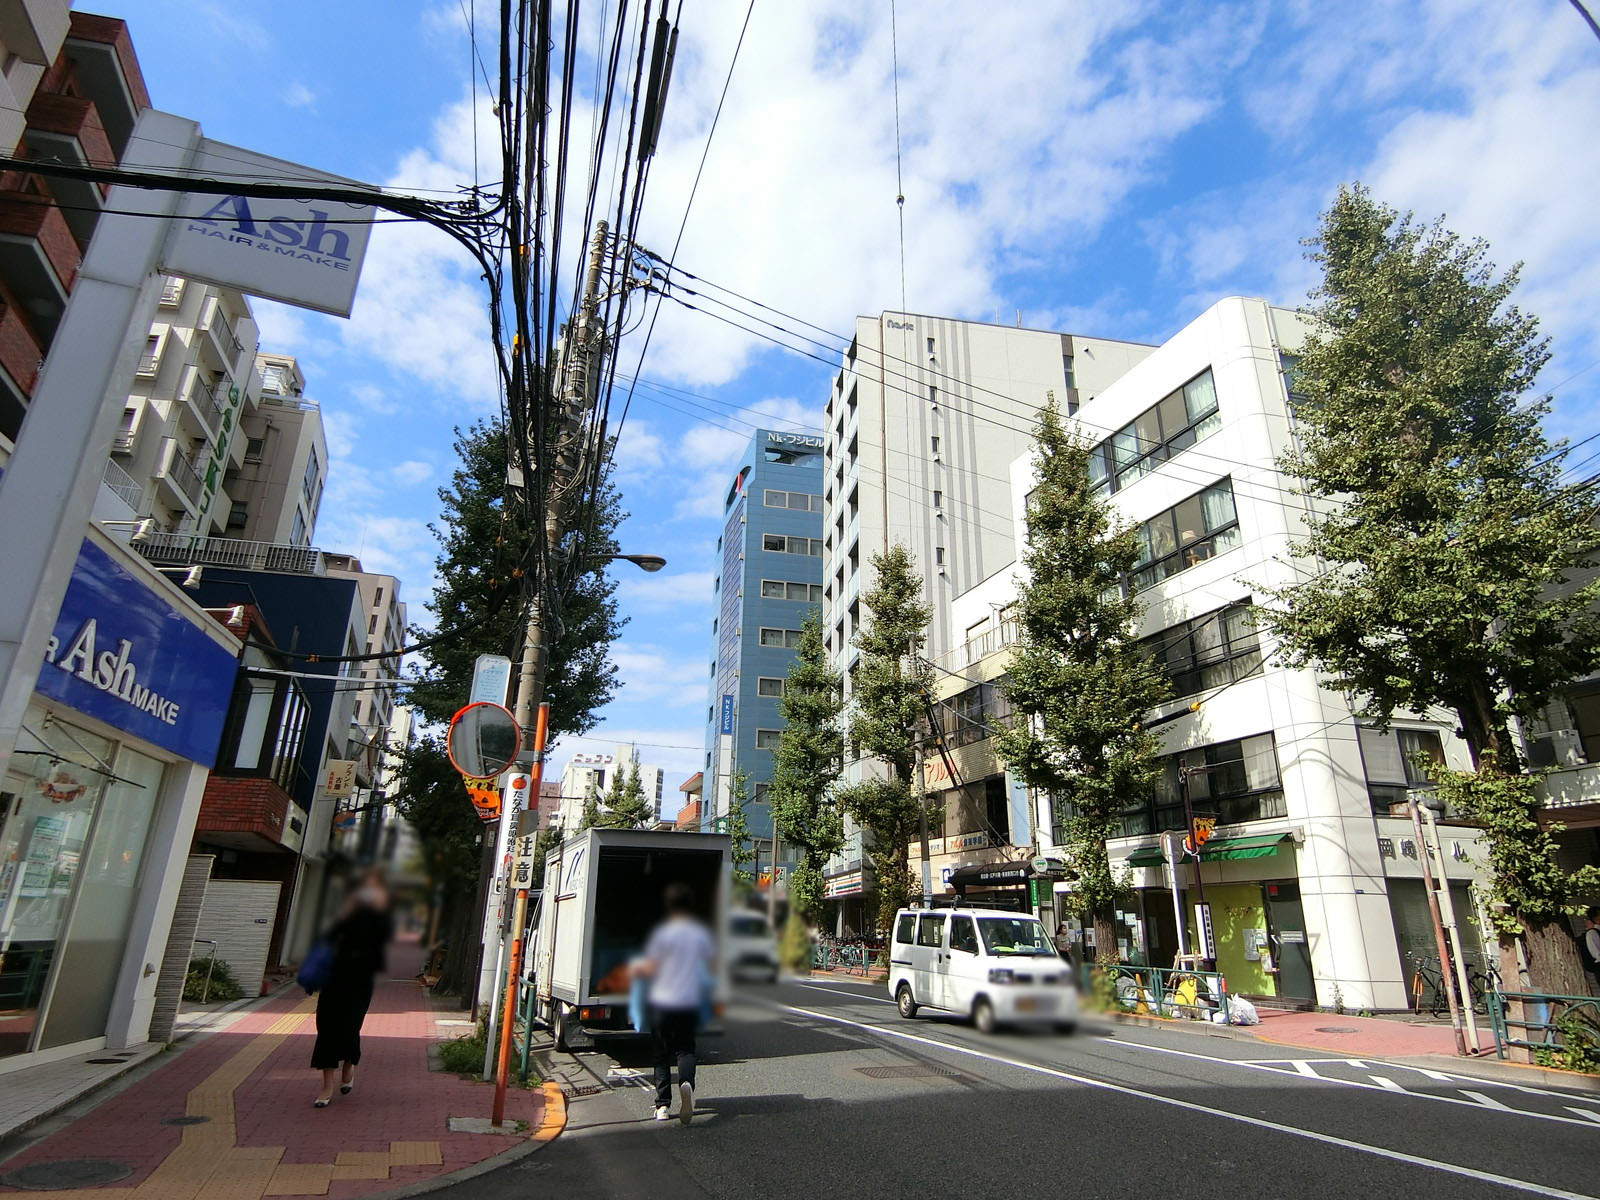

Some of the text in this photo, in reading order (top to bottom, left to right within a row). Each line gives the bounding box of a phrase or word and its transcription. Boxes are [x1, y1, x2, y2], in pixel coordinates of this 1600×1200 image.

[194, 195, 351, 261] Ash
[57, 617, 137, 702] Ash
[130, 683, 180, 726] MAKE
[513, 835, 533, 883] 注意
